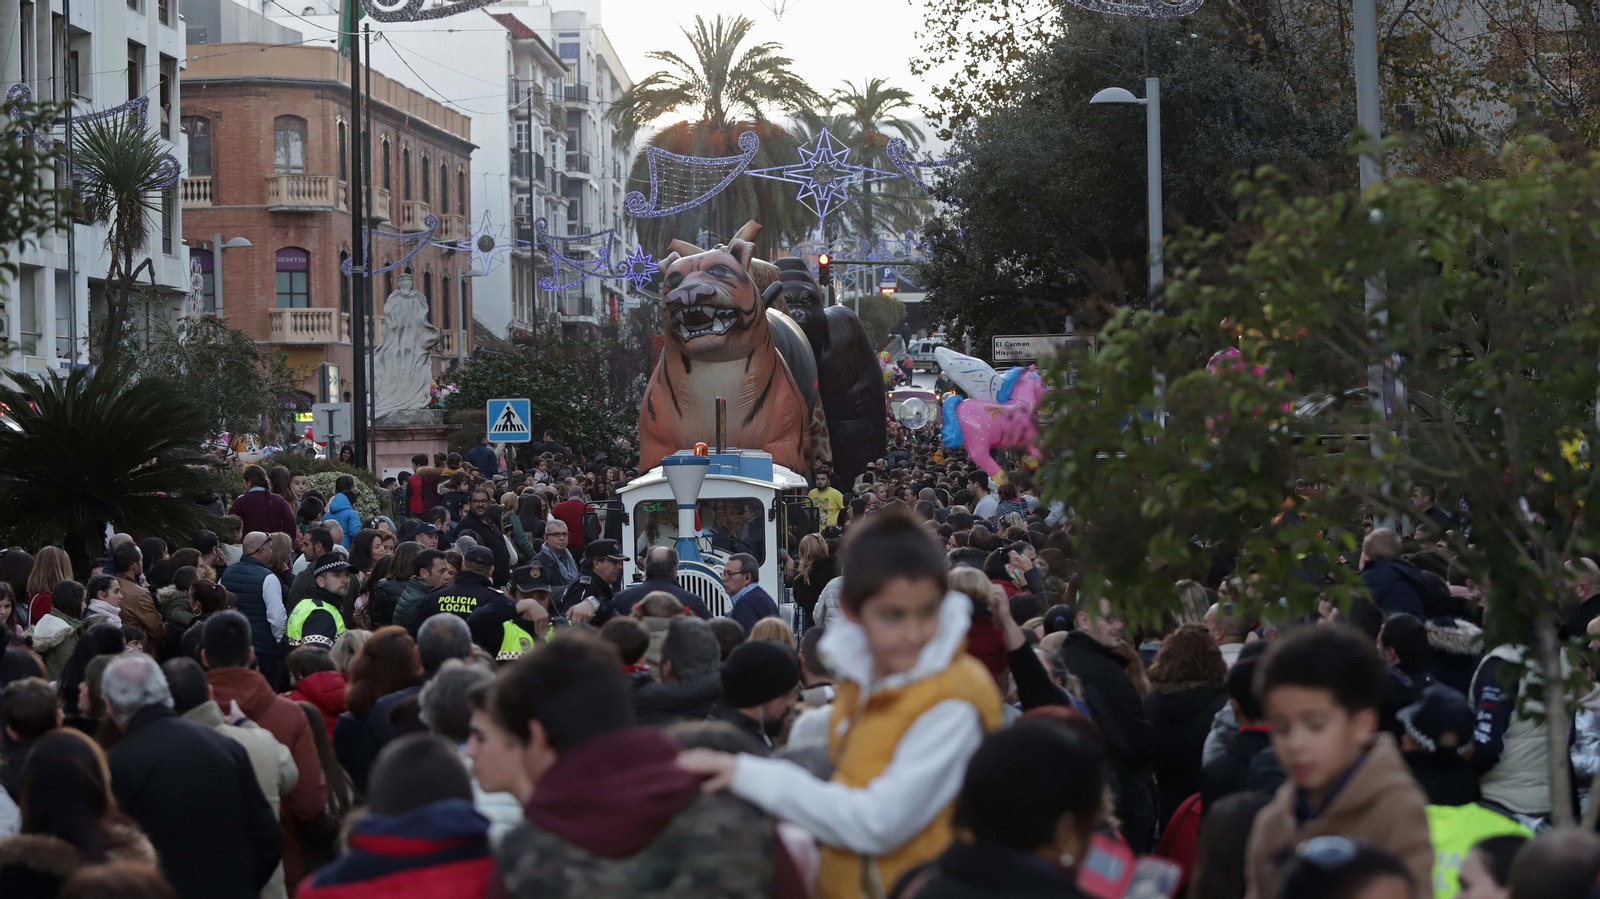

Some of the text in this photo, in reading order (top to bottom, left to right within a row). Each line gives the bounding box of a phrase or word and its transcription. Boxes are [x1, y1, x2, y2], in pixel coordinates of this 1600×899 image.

[884, 268, 891, 277] P
[437, 595, 478, 606] POLICIA
[439, 603, 473, 614] LOCAL
